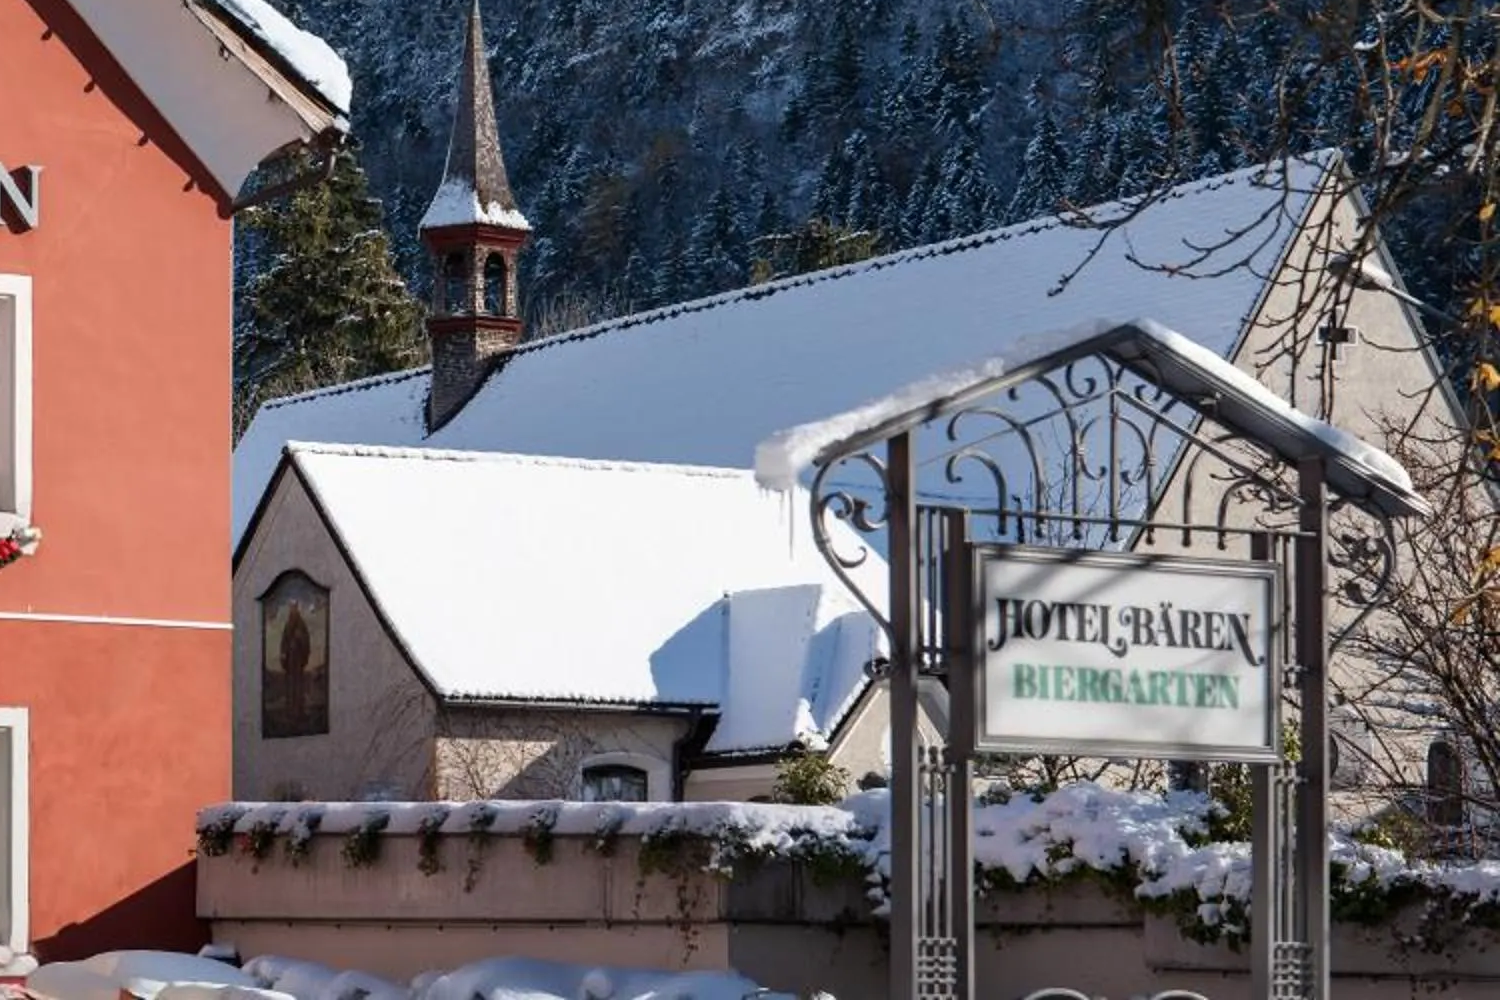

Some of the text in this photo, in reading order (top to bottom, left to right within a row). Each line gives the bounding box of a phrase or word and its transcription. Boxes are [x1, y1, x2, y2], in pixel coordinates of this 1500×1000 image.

[988, 597, 1266, 666] HOTEL BÄREN
[1011, 662, 1241, 710] BIERGARTEN
